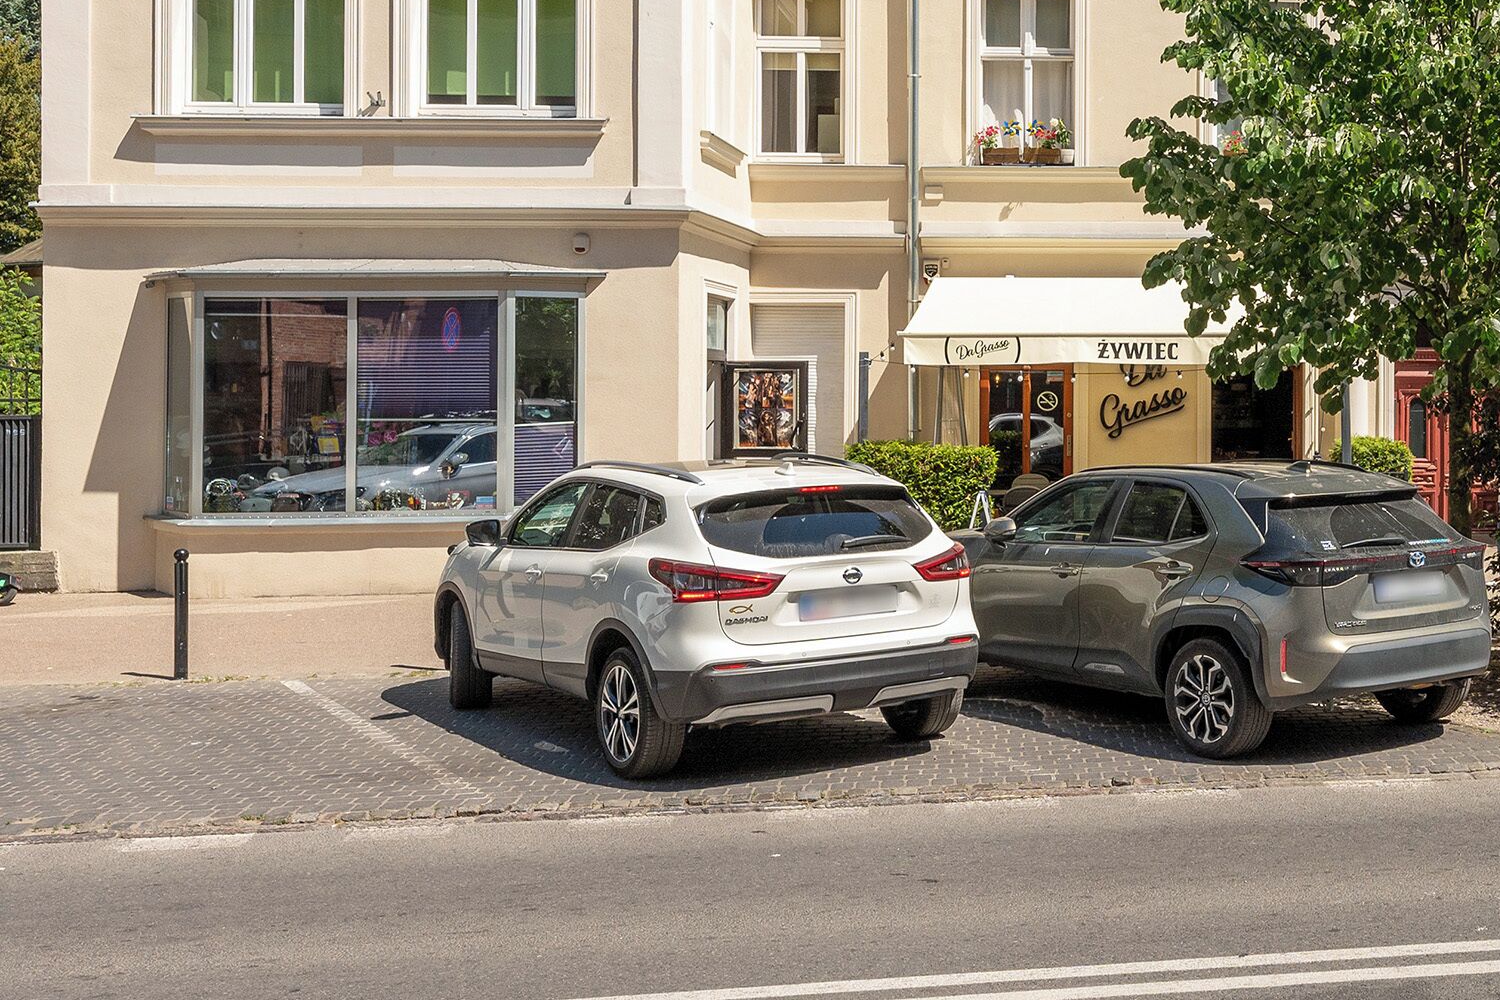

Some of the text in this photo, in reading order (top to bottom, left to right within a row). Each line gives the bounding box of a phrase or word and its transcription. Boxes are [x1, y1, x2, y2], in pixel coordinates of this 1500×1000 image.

[956, 339, 1010, 360] Da Grasso
[1097, 339, 1179, 361] ŻYWIEC
[1099, 386, 1187, 439] Grasso
